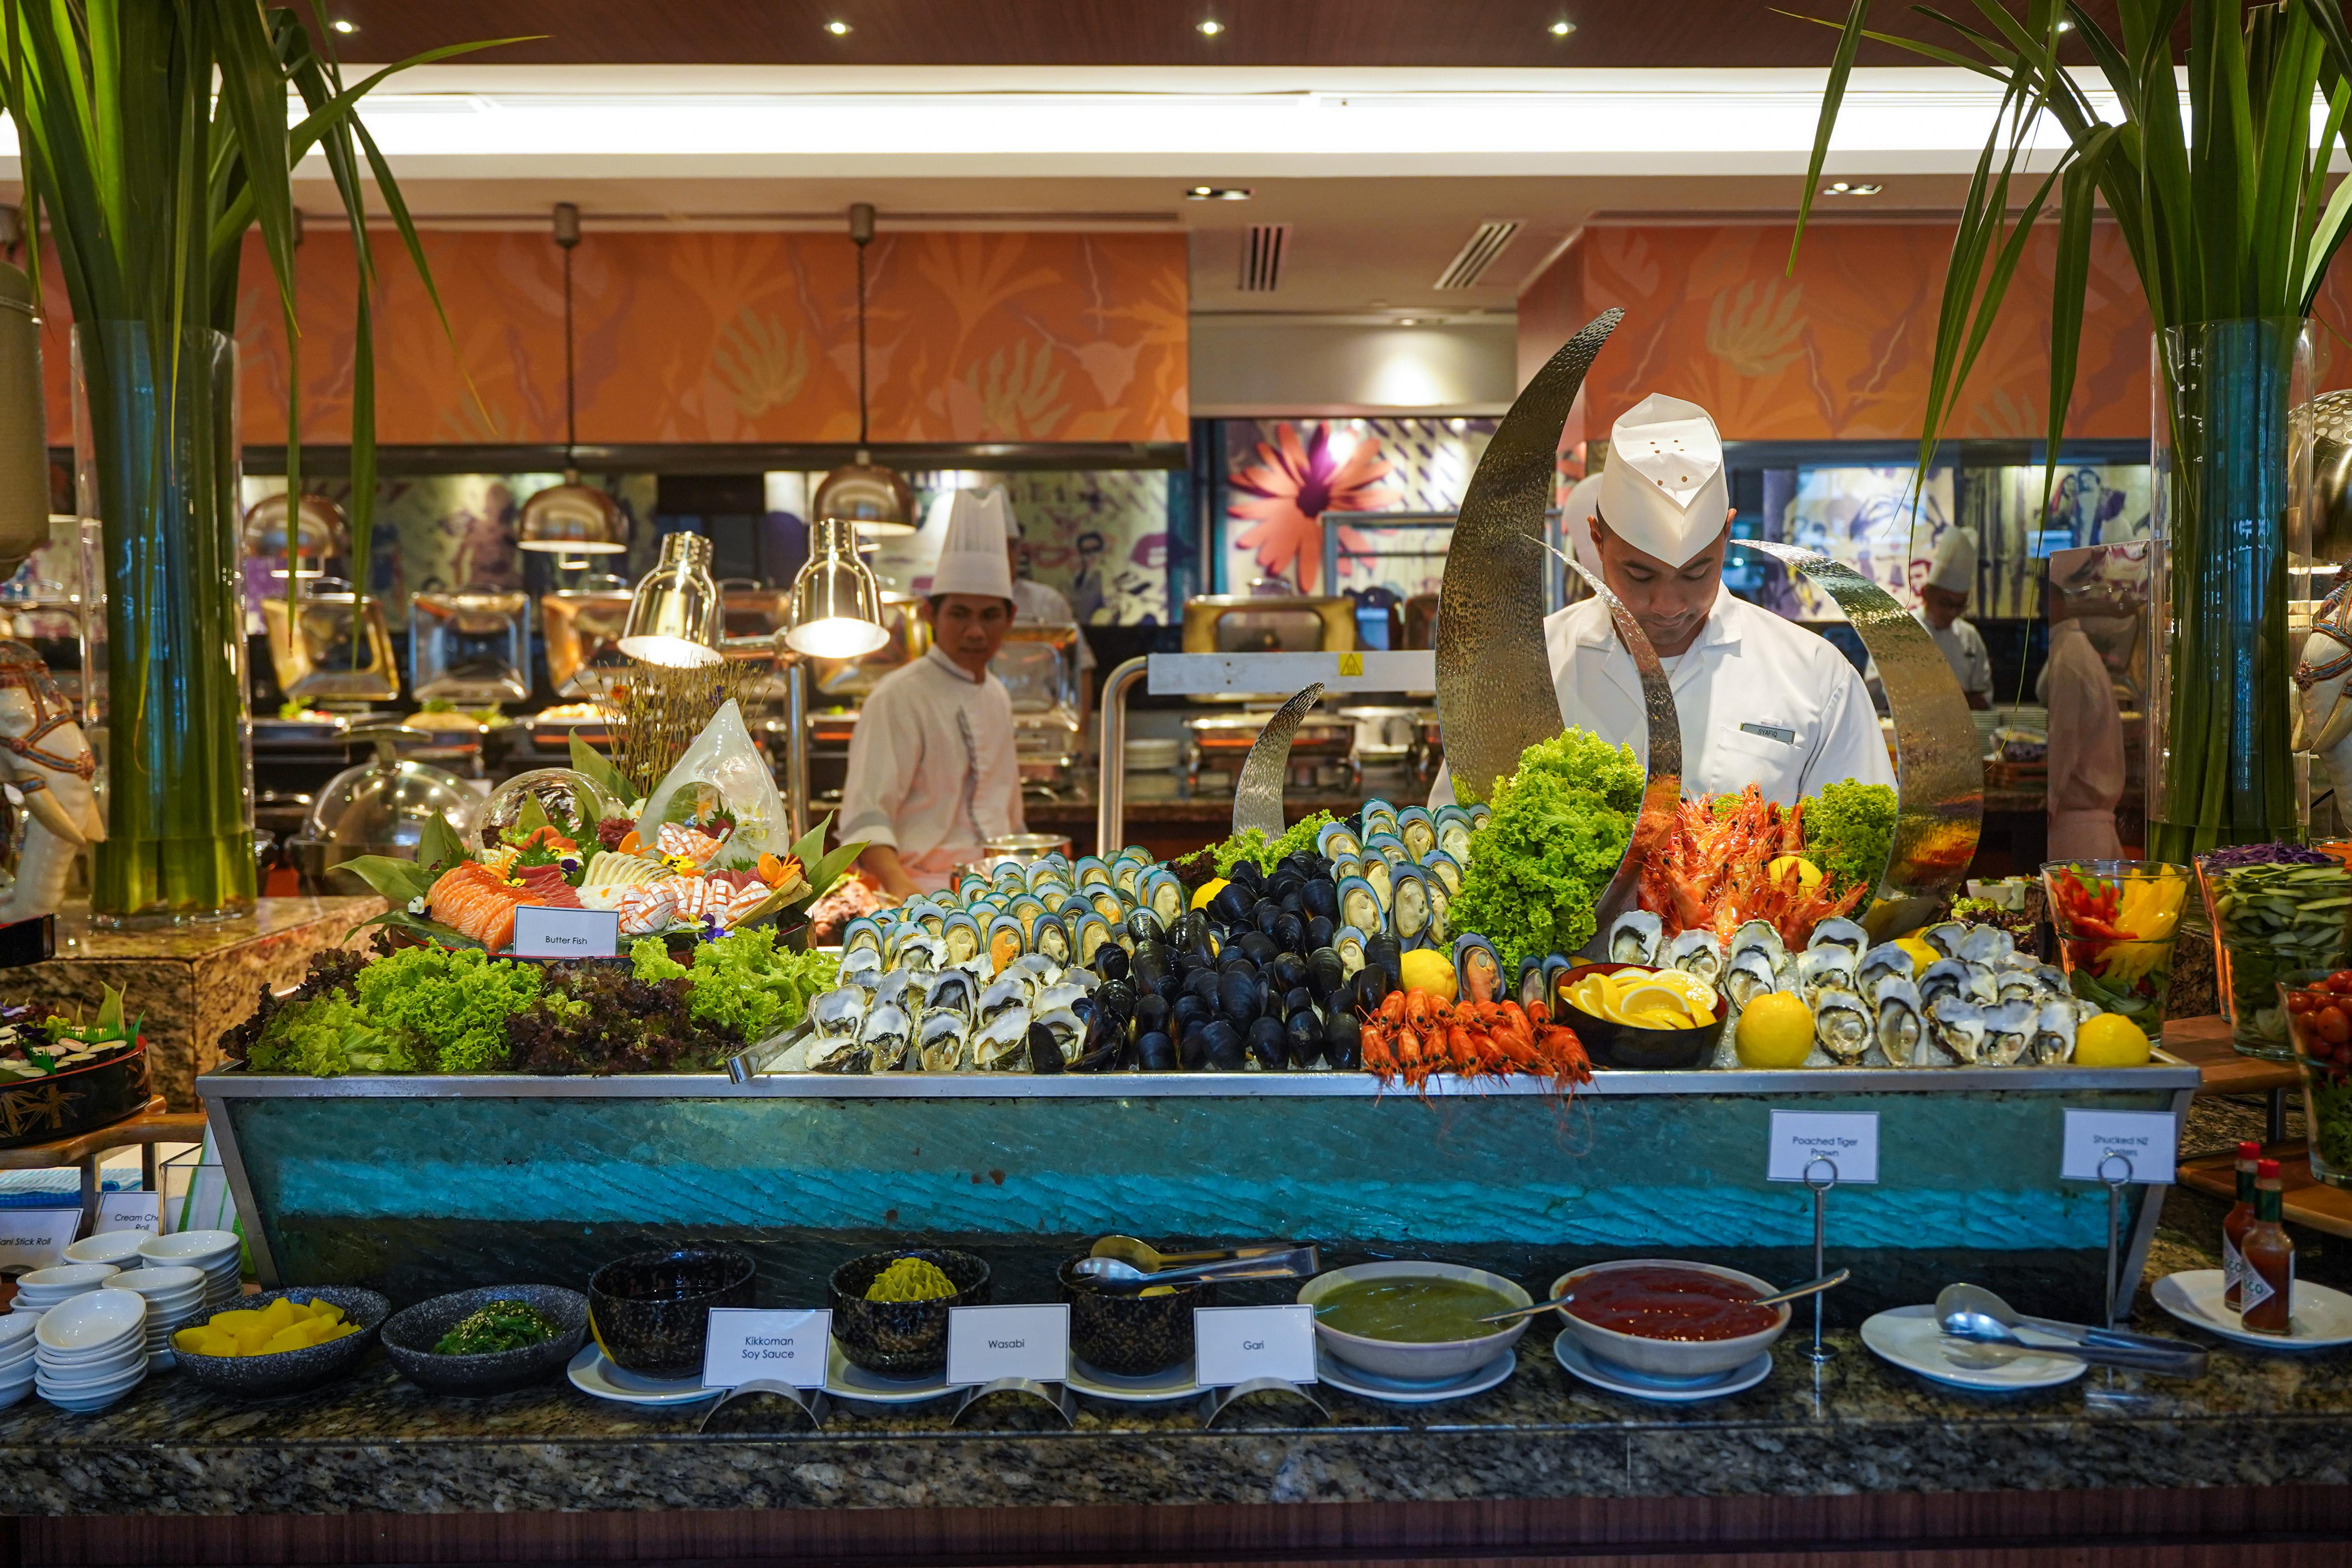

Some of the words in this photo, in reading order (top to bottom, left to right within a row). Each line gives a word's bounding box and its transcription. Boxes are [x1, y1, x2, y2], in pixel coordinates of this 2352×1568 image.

[1758, 729, 1778, 738] SYAFIQ
[545, 935, 570, 944] Butter
[1792, 1136, 1834, 1146] Poached
[1837, 1137, 1859, 1147] Tiger
[2093, 1134, 2135, 1145] Shucked
[1810, 1148, 1839, 1156] Prawn
[745, 1337, 794, 1346] Kikkoman
[988, 1339, 1025, 1349] Wasabi
[1243, 1340, 1264, 1350] Gari
[742, 1349, 760, 1360] Soy
[762, 1349, 794, 1358] Sauce
